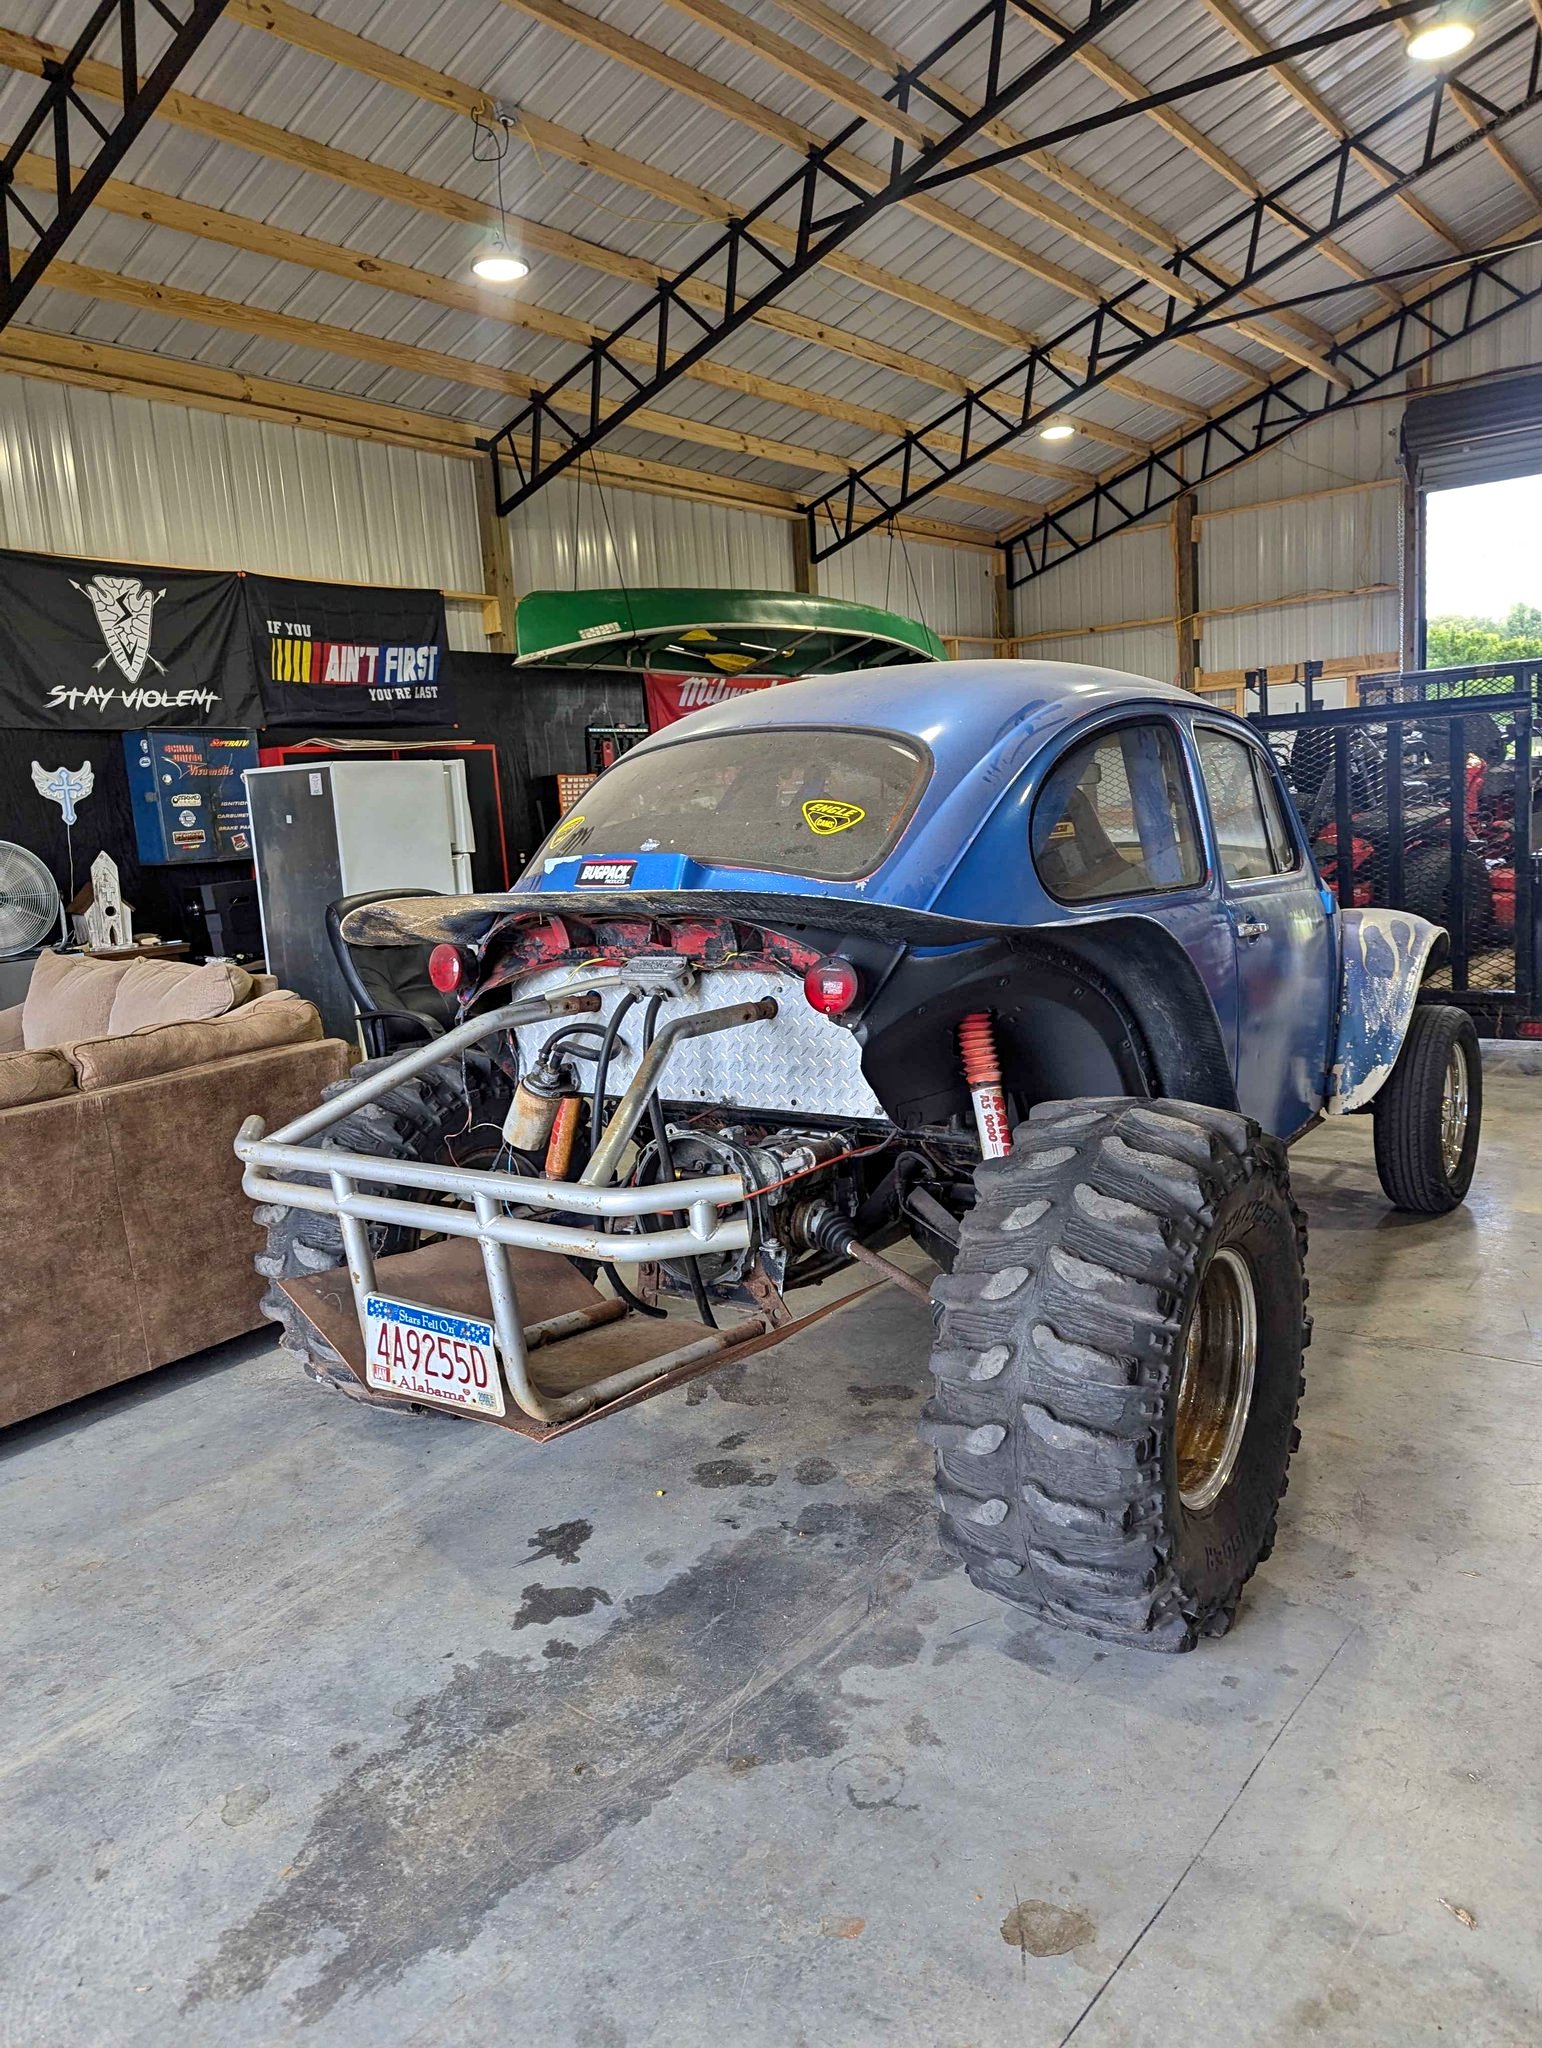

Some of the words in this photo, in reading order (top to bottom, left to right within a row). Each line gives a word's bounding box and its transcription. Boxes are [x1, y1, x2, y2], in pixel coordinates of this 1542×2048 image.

[266, 620, 281, 634] IF
[285, 622, 311, 637] YOU
[324, 645, 379, 682] AIN'T
[384, 646, 438, 682] FIRST
[43, 685, 115, 713] STAY
[121, 686, 222, 713] VIOLENT
[368, 687, 411, 701] YOU'RE
[414, 686, 438, 699] LAST
[678, 676, 778, 707] Milw
[808, 804, 857, 817] ENGLE
[816, 819, 834, 828] CAMS
[581, 865, 632, 880] BUGPACK
[984, 1114, 998, 1142] 9000
[398, 1309, 420, 1323] Stars
[421, 1314, 439, 1327] Fell
[439, 1320, 455, 1334] On
[377, 1322, 488, 1389] 4A9255D
[374, 1367, 387, 1380] JAN
[398, 1375, 467, 1403] Alabama
